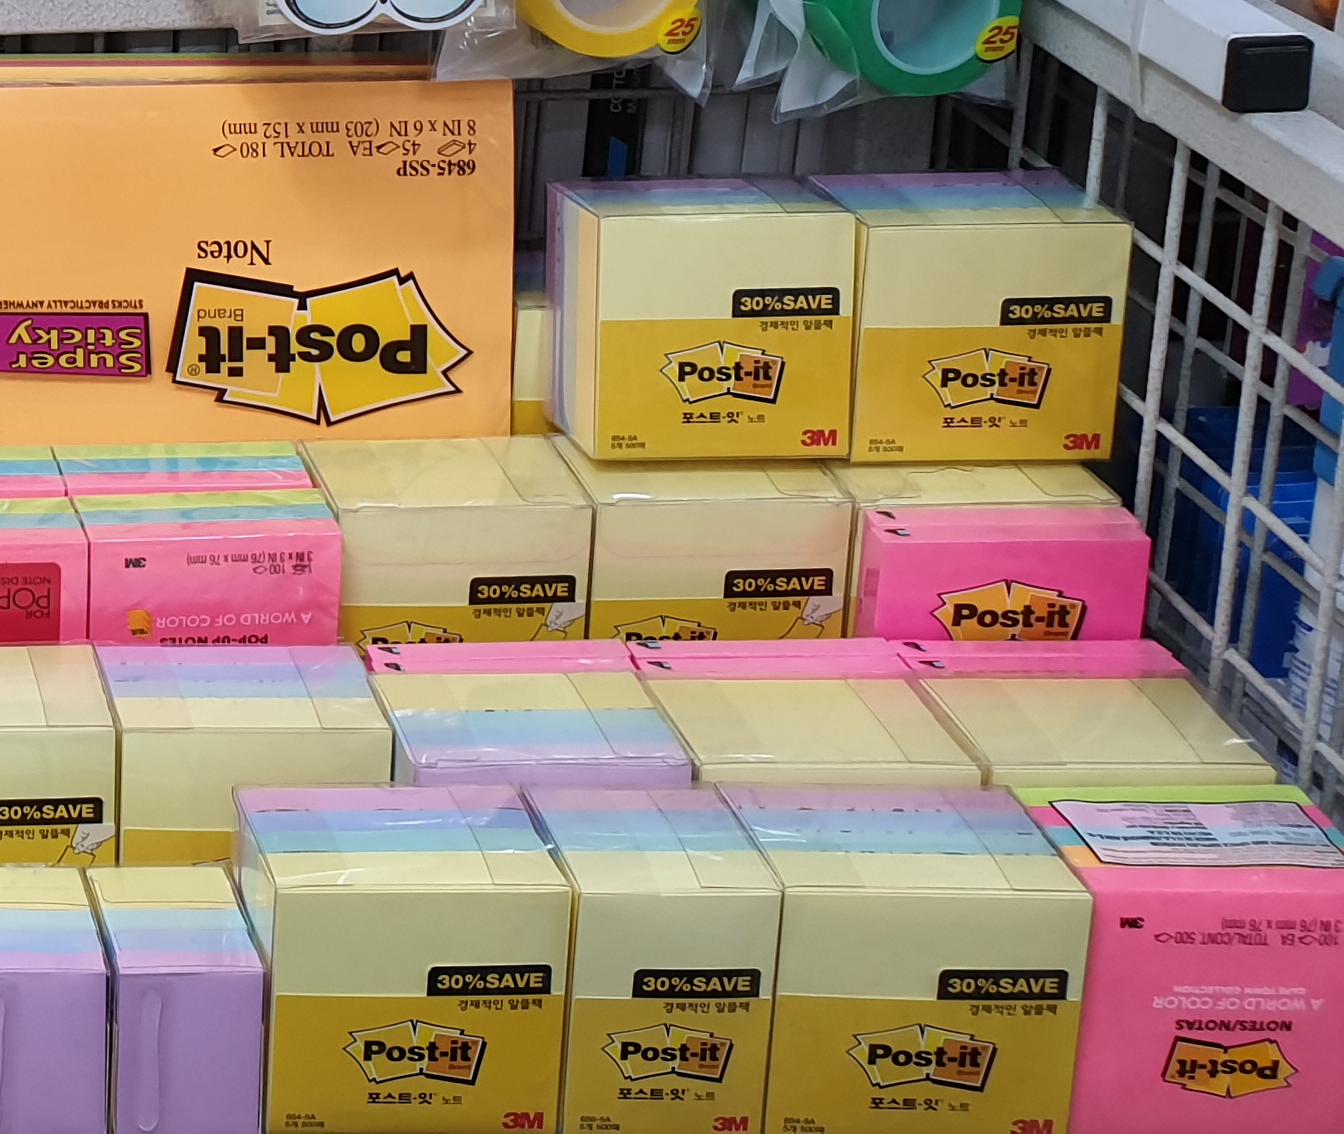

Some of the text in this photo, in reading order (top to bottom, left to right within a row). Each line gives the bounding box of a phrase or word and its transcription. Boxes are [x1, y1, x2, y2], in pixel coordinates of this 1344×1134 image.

[981, 26, 1018, 49] 25
[221, 118, 477, 138] 8 IN x 6 IN (203 mm x 152 mm)
[240, 142, 266, 158] 180
[274, 141, 334, 157] TOTAL
[349, 140, 374, 156] EA
[402, 140, 421, 155] 45
[197, 240, 272, 266] Notes
[740, 292, 834, 314] 30%SAVE
[1009, 300, 1104, 321] 30%SAVE
[197, 308, 245, 322] Brand
[197, 323, 428, 377] Post-it
[941, 365, 1039, 391] Post-it
[800, 428, 837, 448] 3M
[1063, 432, 1101, 452] 3M
[24, 577, 51, 585] NOTE
[732, 576, 827, 595] 30%SAVE
[477, 583, 570, 602] 30%SAVE
[156, 613, 312, 629] A WORLD OF COLOR
[437, 973, 544, 991] 30%SAVE
[642, 976, 752, 994] 30%SAVE
[1153, 996, 1212, 1009] COLOR
[1216, 996, 1239, 1010] OF
[1244, 998, 1306, 1010] WORLD
[1175, 1020, 1292, 1032] NOTES/NOTAS
[363, 1038, 472, 1065] Post-it
